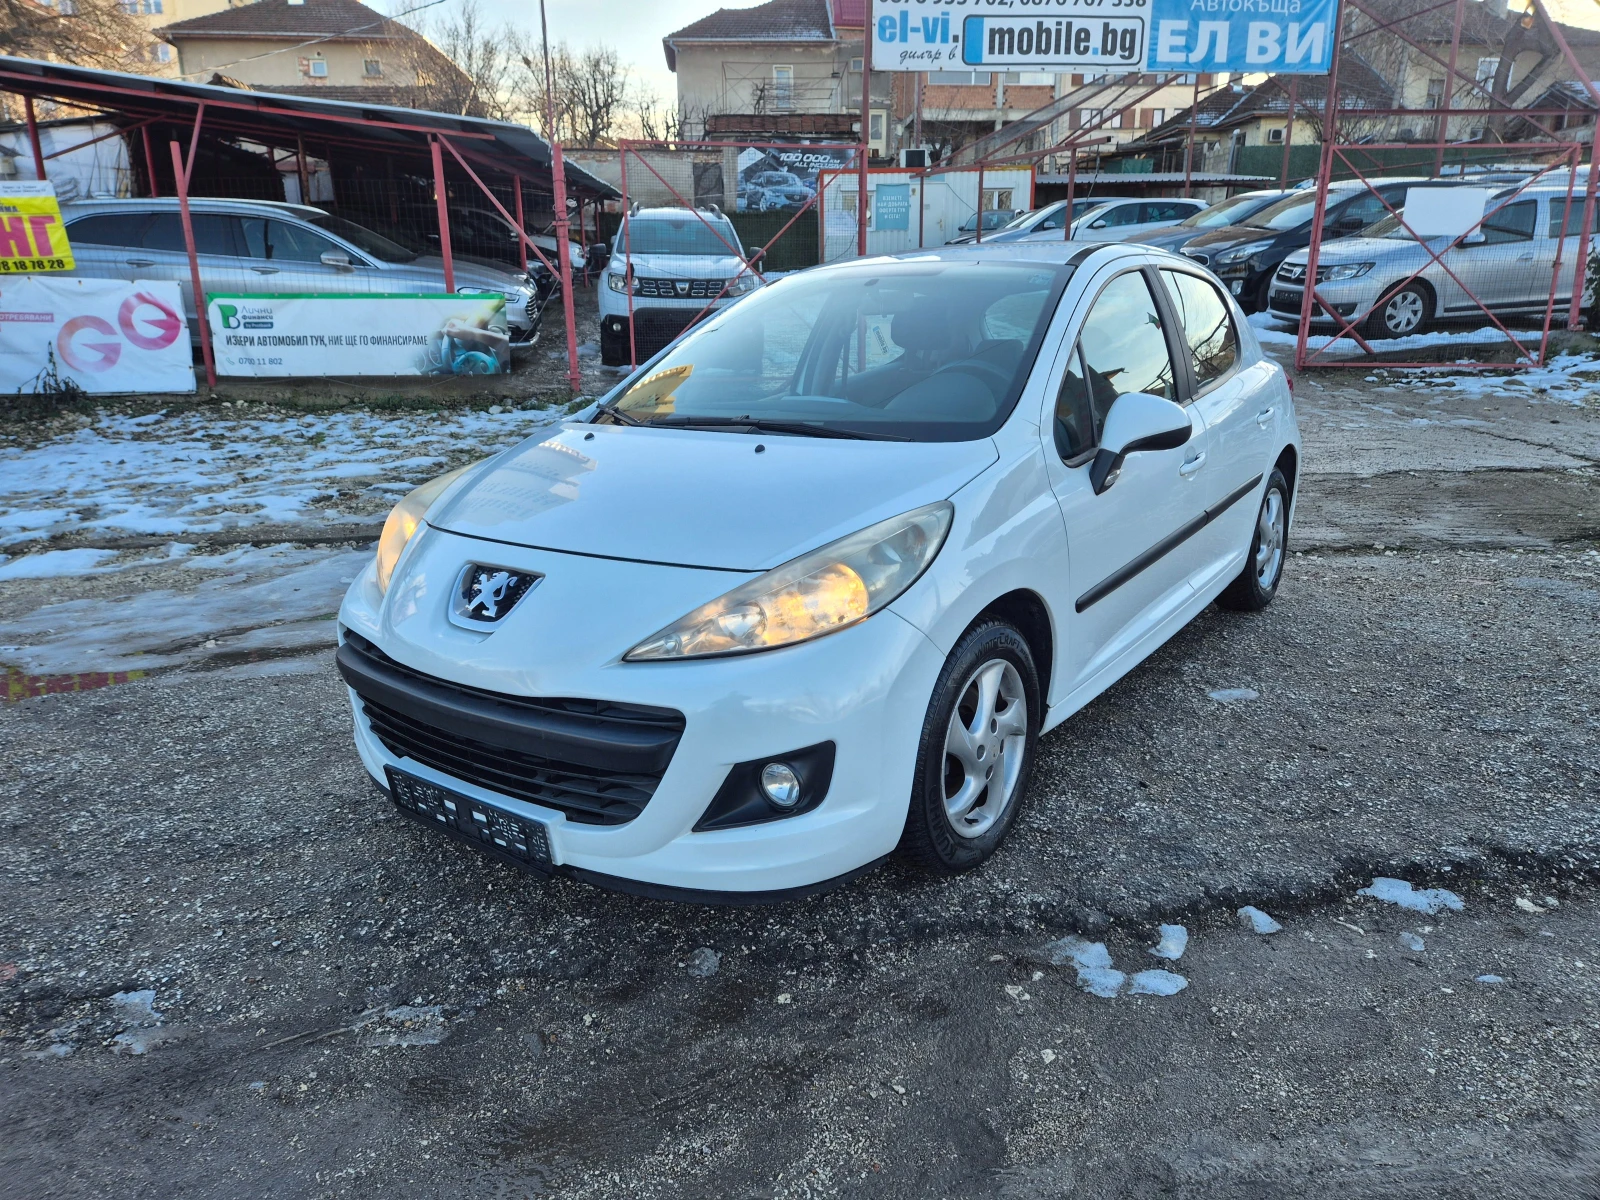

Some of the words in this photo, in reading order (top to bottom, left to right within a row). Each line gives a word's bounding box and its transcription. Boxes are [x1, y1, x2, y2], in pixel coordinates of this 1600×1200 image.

[1190, 0, 1300, 16] Автокъща
[988, 21, 1137, 60] mobile.bg
[1156, 20, 1230, 63] ЕЛ
[1245, 21, 1325, 64] ВИ
[900, 48, 941, 64] дилър
[948, 45, 958, 60] в
[779, 152, 803, 162] 100
[802, 153, 831, 163] 000
[12, 260, 28, 270] 18
[29, 260, 46, 270] 78
[47, 259, 65, 269] 28
[241, 305, 273, 314] Лични
[257, 335, 308, 347] АВТОМОБИЛ
[309, 335, 327, 347] ТУК,
[328, 335, 344, 346] НИЕ
[345, 335, 358, 347] ЩЕ
[359, 335, 369, 346] ГО
[370, 335, 428, 346] ФИНАНСИРАМЕ
[268, 357, 283, 365] 802
